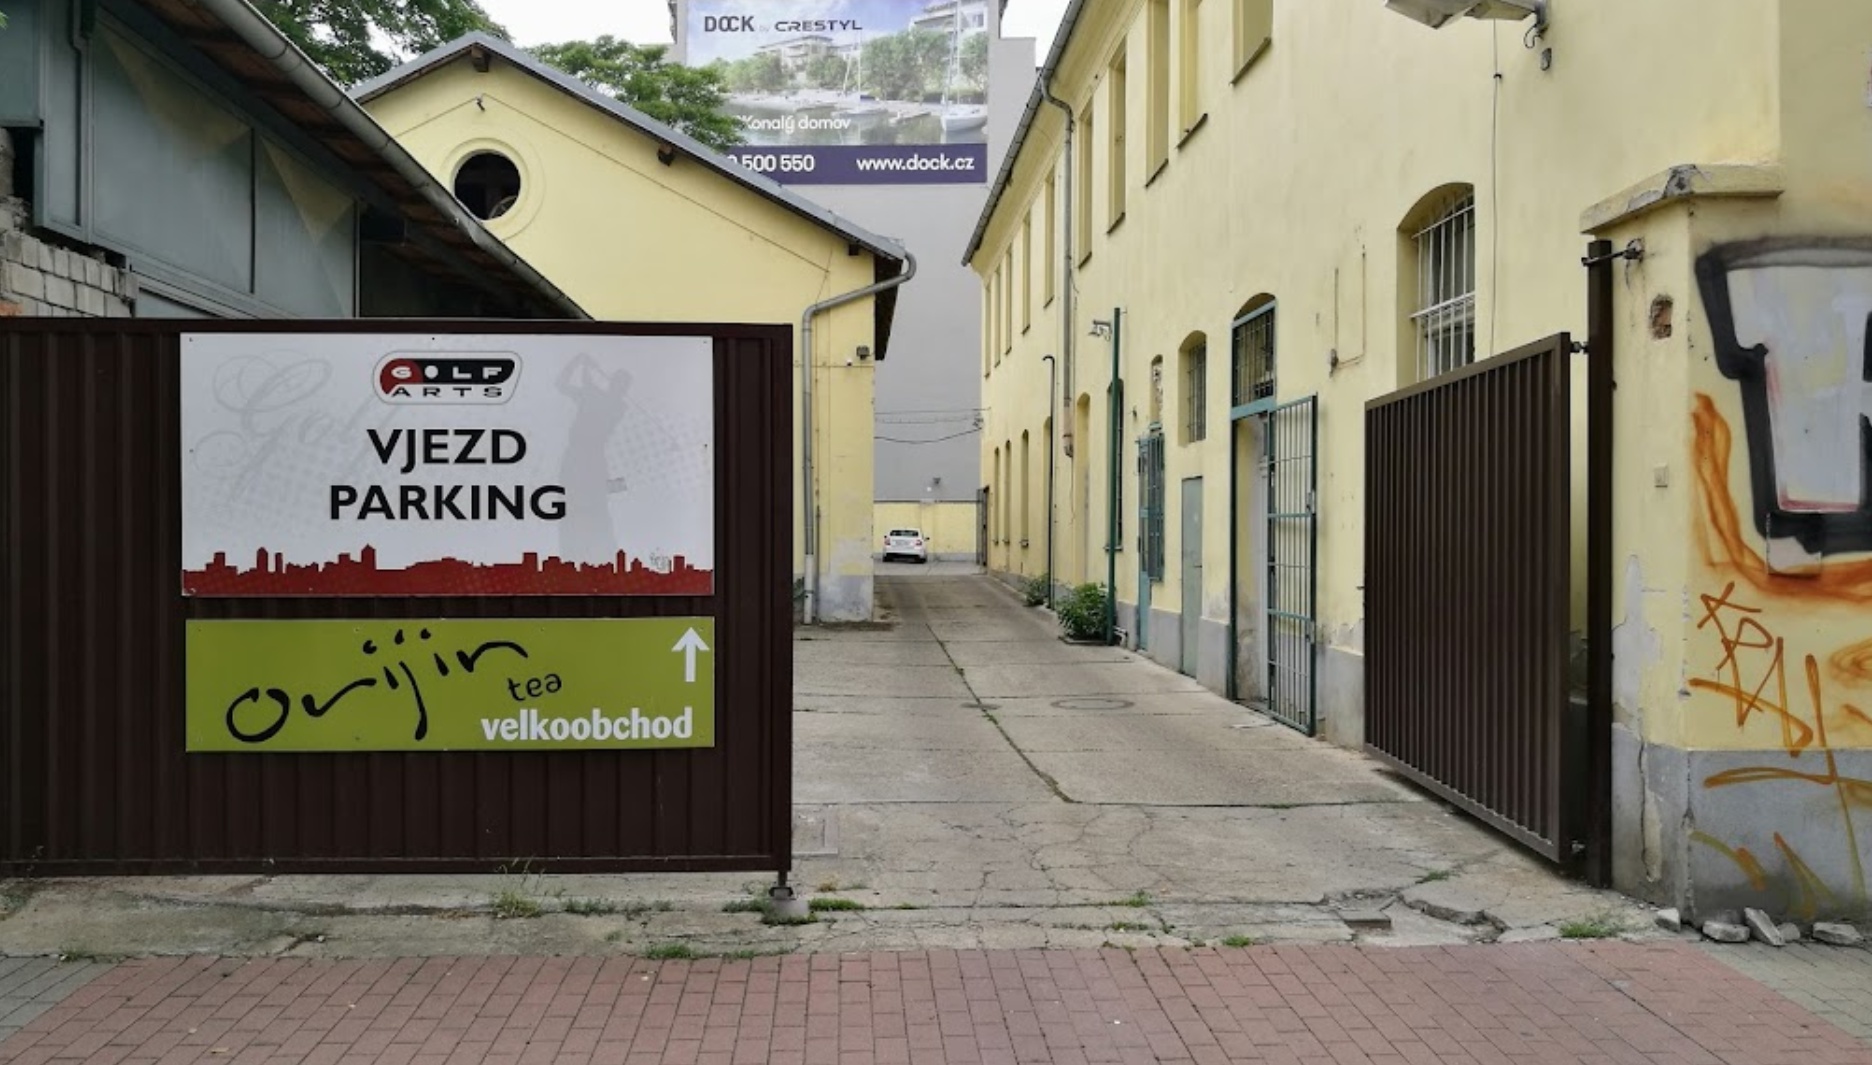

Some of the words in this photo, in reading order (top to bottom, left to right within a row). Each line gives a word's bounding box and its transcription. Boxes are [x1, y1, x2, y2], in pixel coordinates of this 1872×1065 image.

[704, 15, 755, 32] DOCK
[774, 19, 863, 32] CRESTYL
[798, 115, 851, 130] domov
[742, 154, 777, 172] 500
[780, 154, 815, 172] 550
[856, 152, 975, 171] www.dock.cz
[391, 386, 503, 398] ARTS
[366, 429, 527, 474] VJEZD
[330, 485, 567, 520] PARKING
[507, 673, 562, 702] tea
[481, 706, 693, 740] velkoobchod
